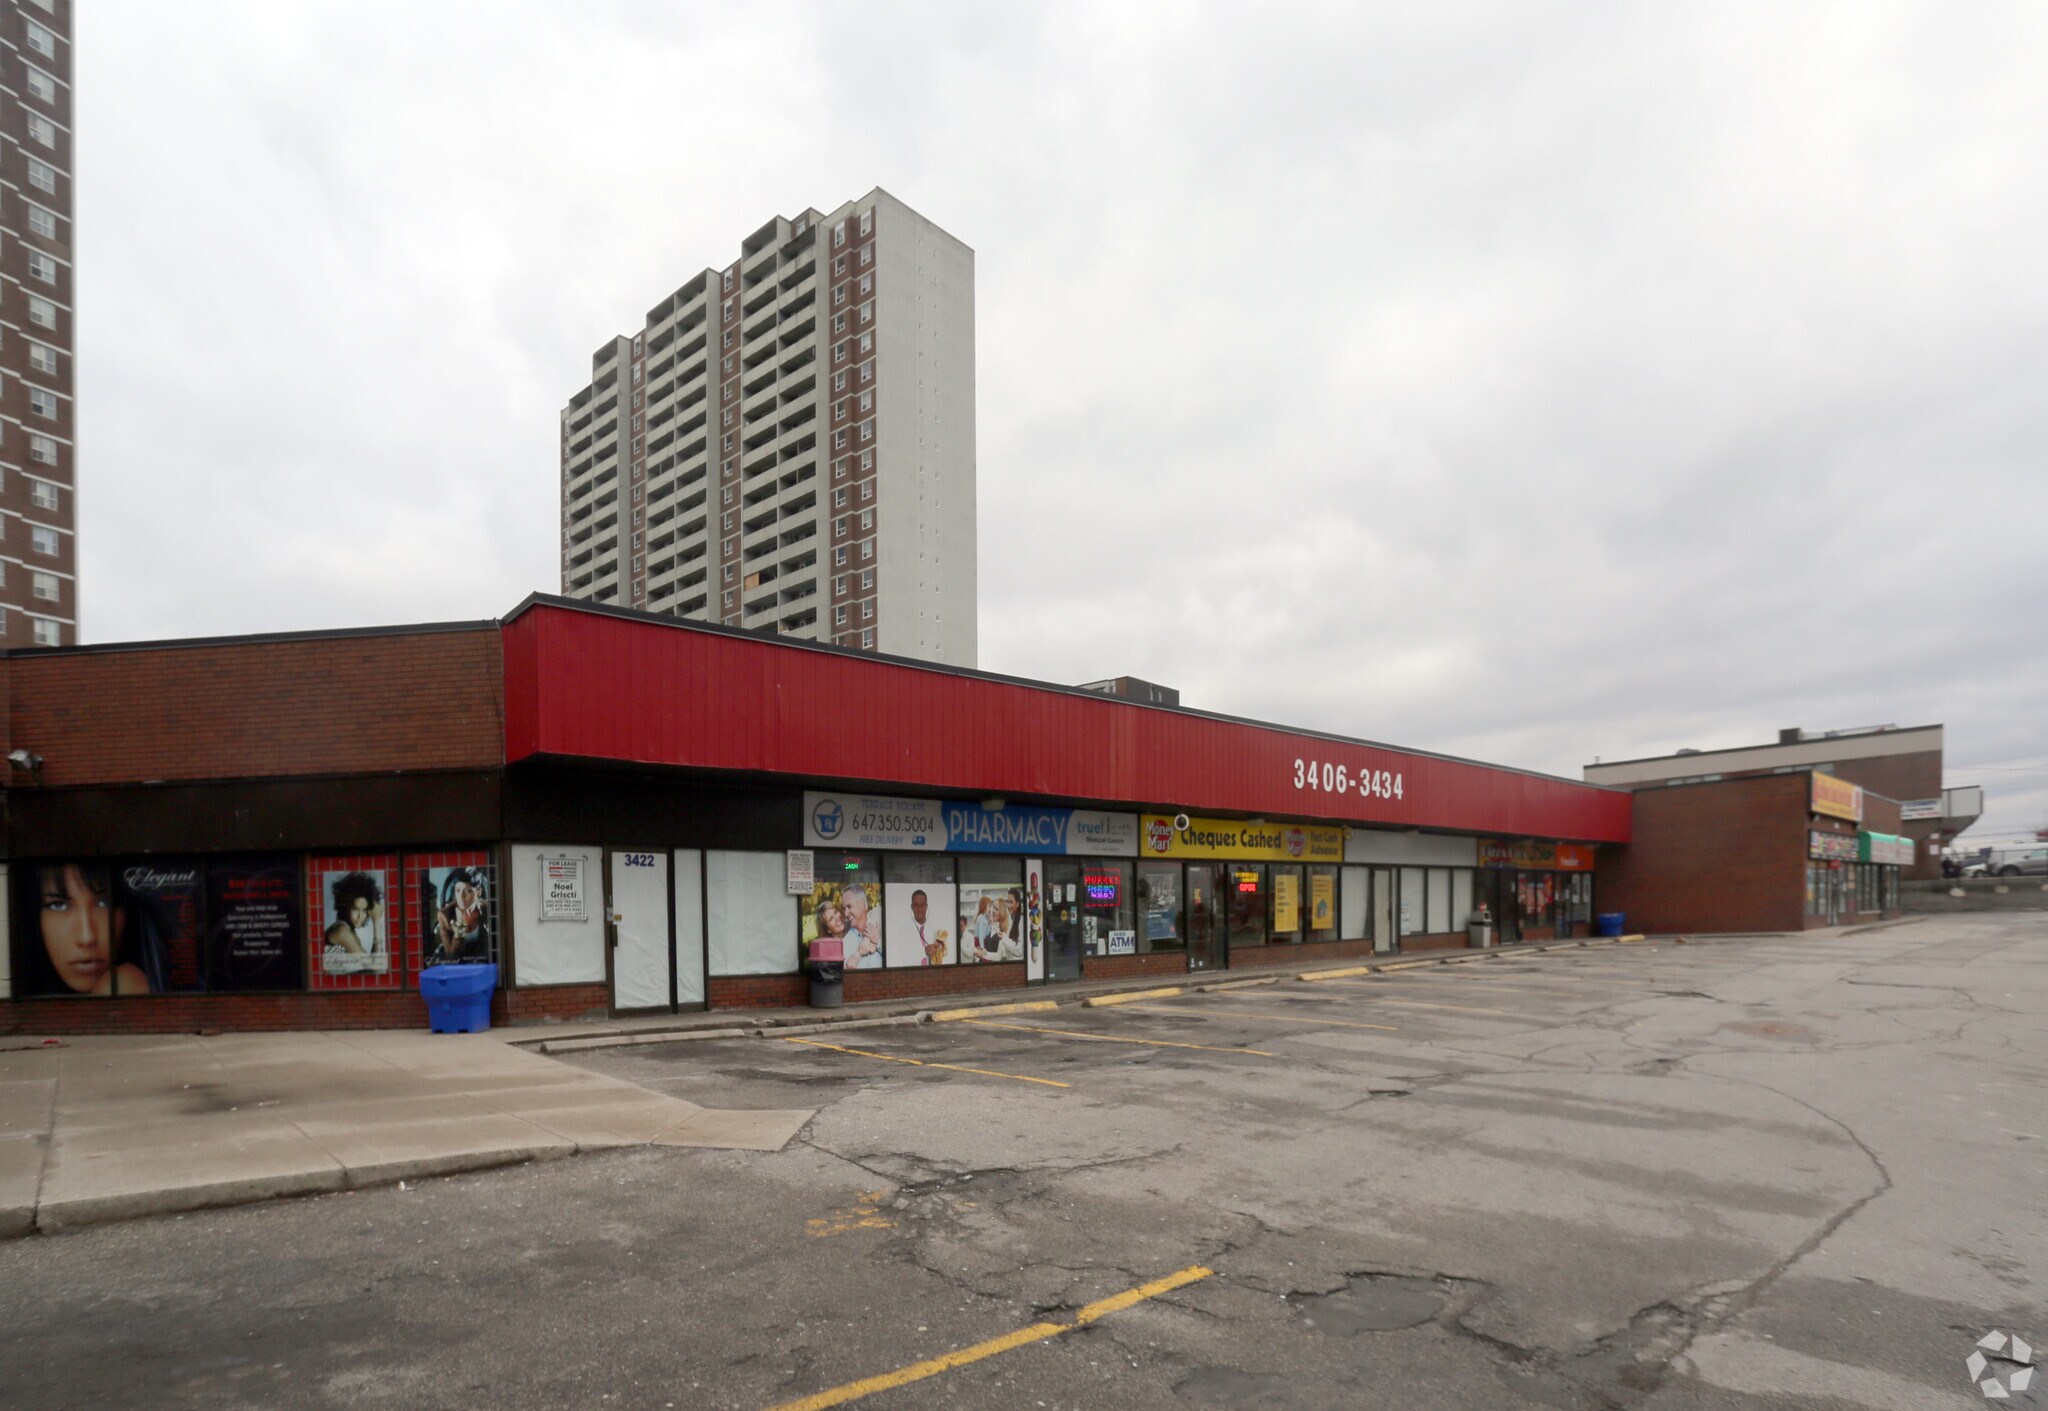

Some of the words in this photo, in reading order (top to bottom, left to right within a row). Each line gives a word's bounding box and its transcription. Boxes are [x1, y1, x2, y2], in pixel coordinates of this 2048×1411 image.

[1293, 758, 1403, 800] 3406-3434
[852, 813, 934, 832] 647.350.5004
[950, 809, 1066, 846] PHARMACY
[1146, 820, 1175, 838] Money
[1148, 836, 1171, 851] Mart
[1181, 826, 1237, 849] Cheques
[1240, 828, 1282, 849] Cashed
[624, 853, 655, 867] 3422
[123, 866, 196, 891] Elegant
[550, 890, 577, 899] Griscti
